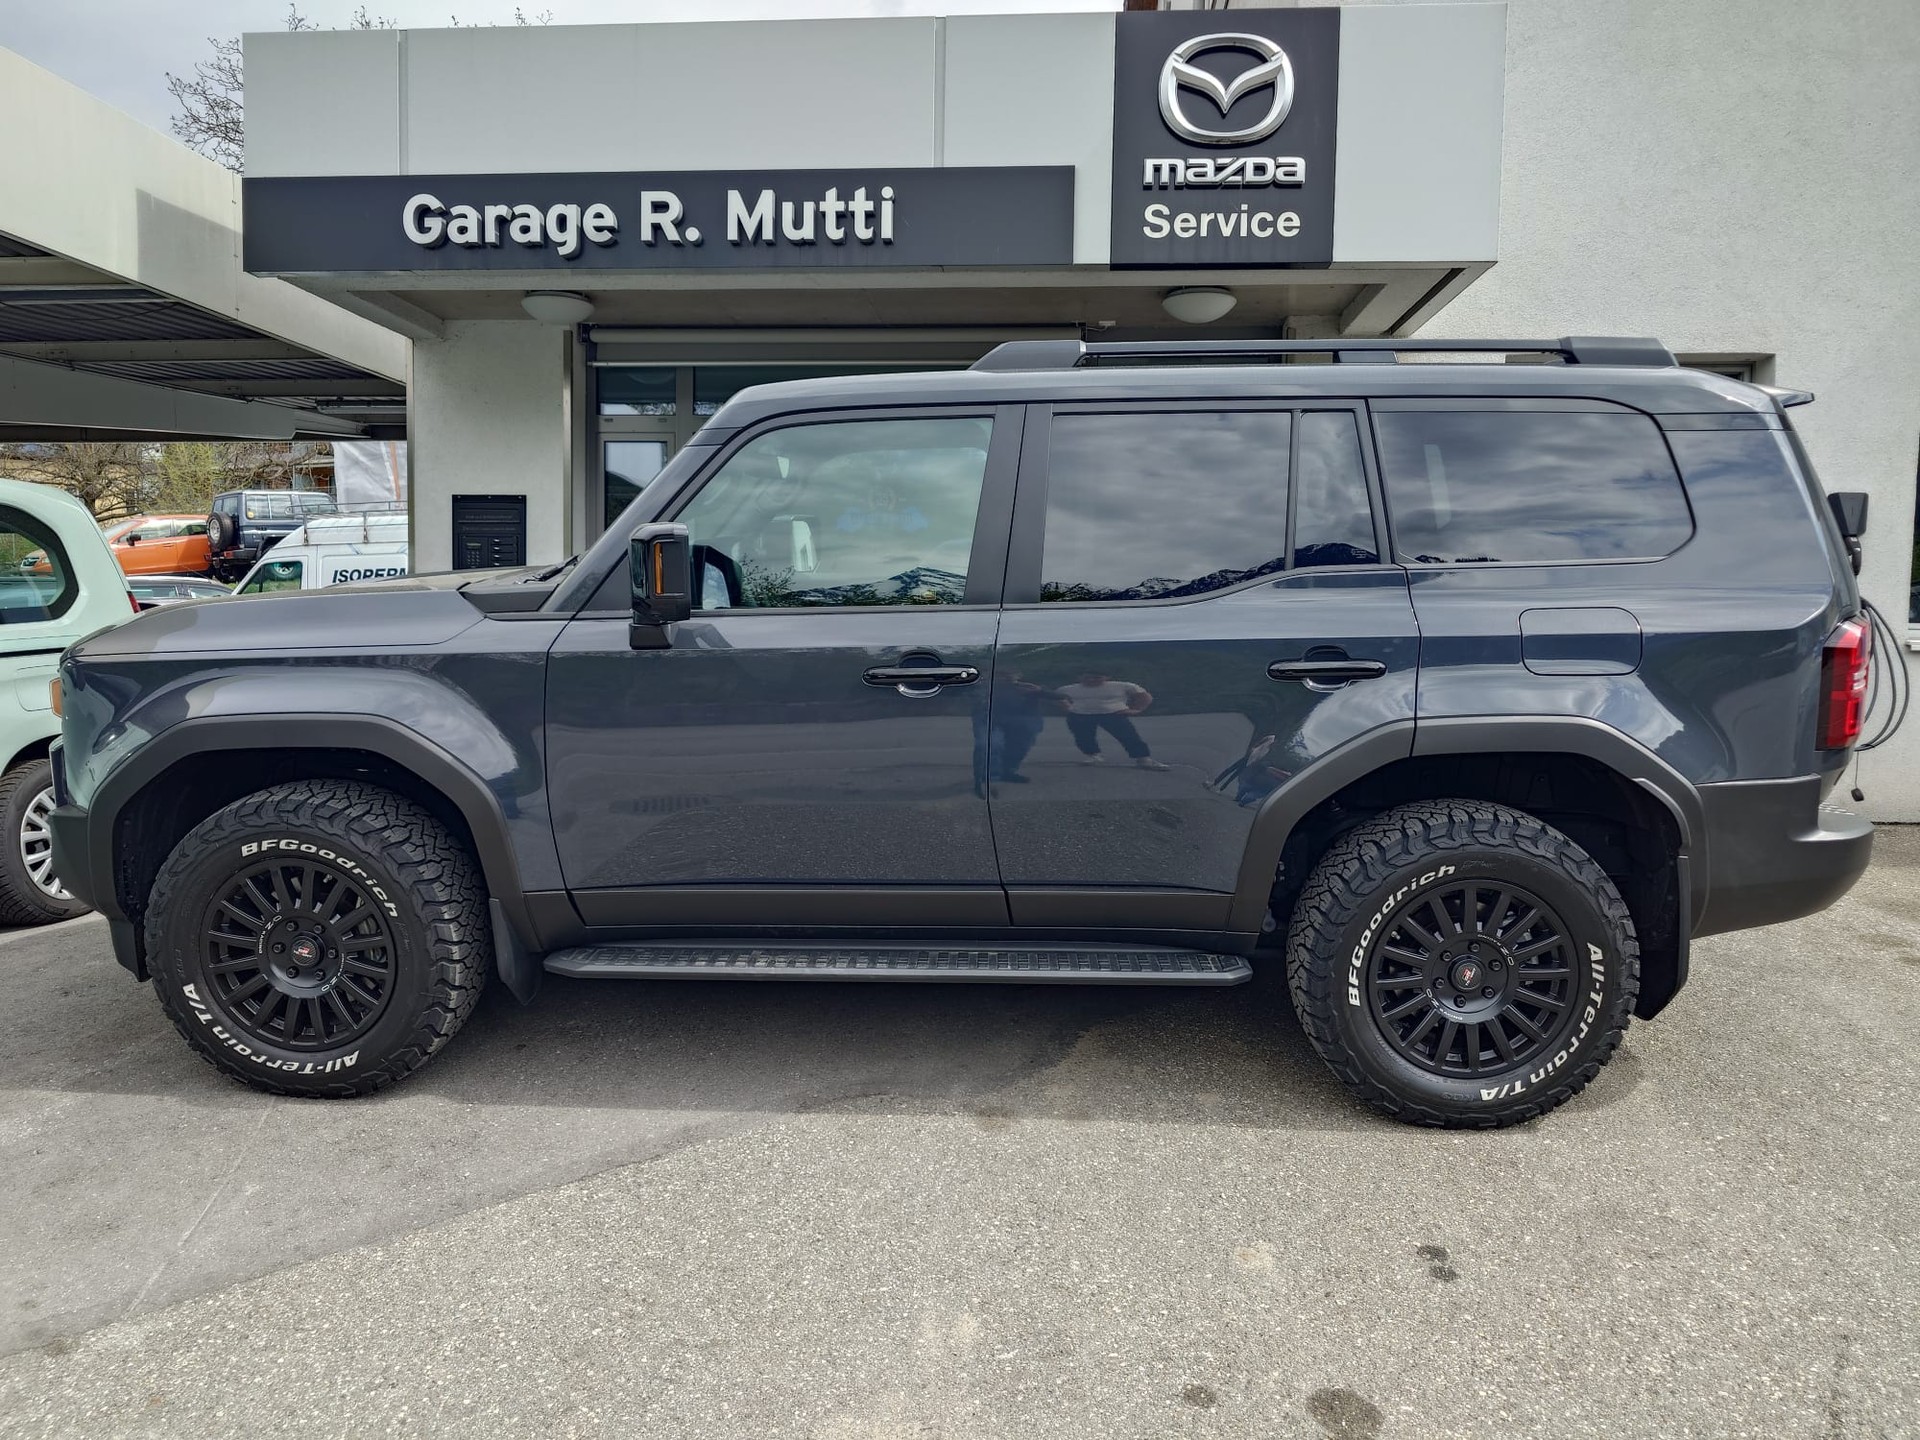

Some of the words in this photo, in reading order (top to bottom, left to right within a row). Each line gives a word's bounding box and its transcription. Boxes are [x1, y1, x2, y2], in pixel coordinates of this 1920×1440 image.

[402, 193, 618, 260] Garage
[640, 190, 702, 246] R.
[726, 186, 896, 246] Mutti
[1143, 203, 1301, 238] Service
[241, 838, 399, 917] BFGoodrich
[1348, 864, 1456, 1007] BFGoodrich
[182, 983, 213, 1025] T/A
[1529, 942, 1605, 1084] All-Terrain
[212, 1025, 360, 1075] All-Terrain
[1480, 1080, 1526, 1101] T/A
